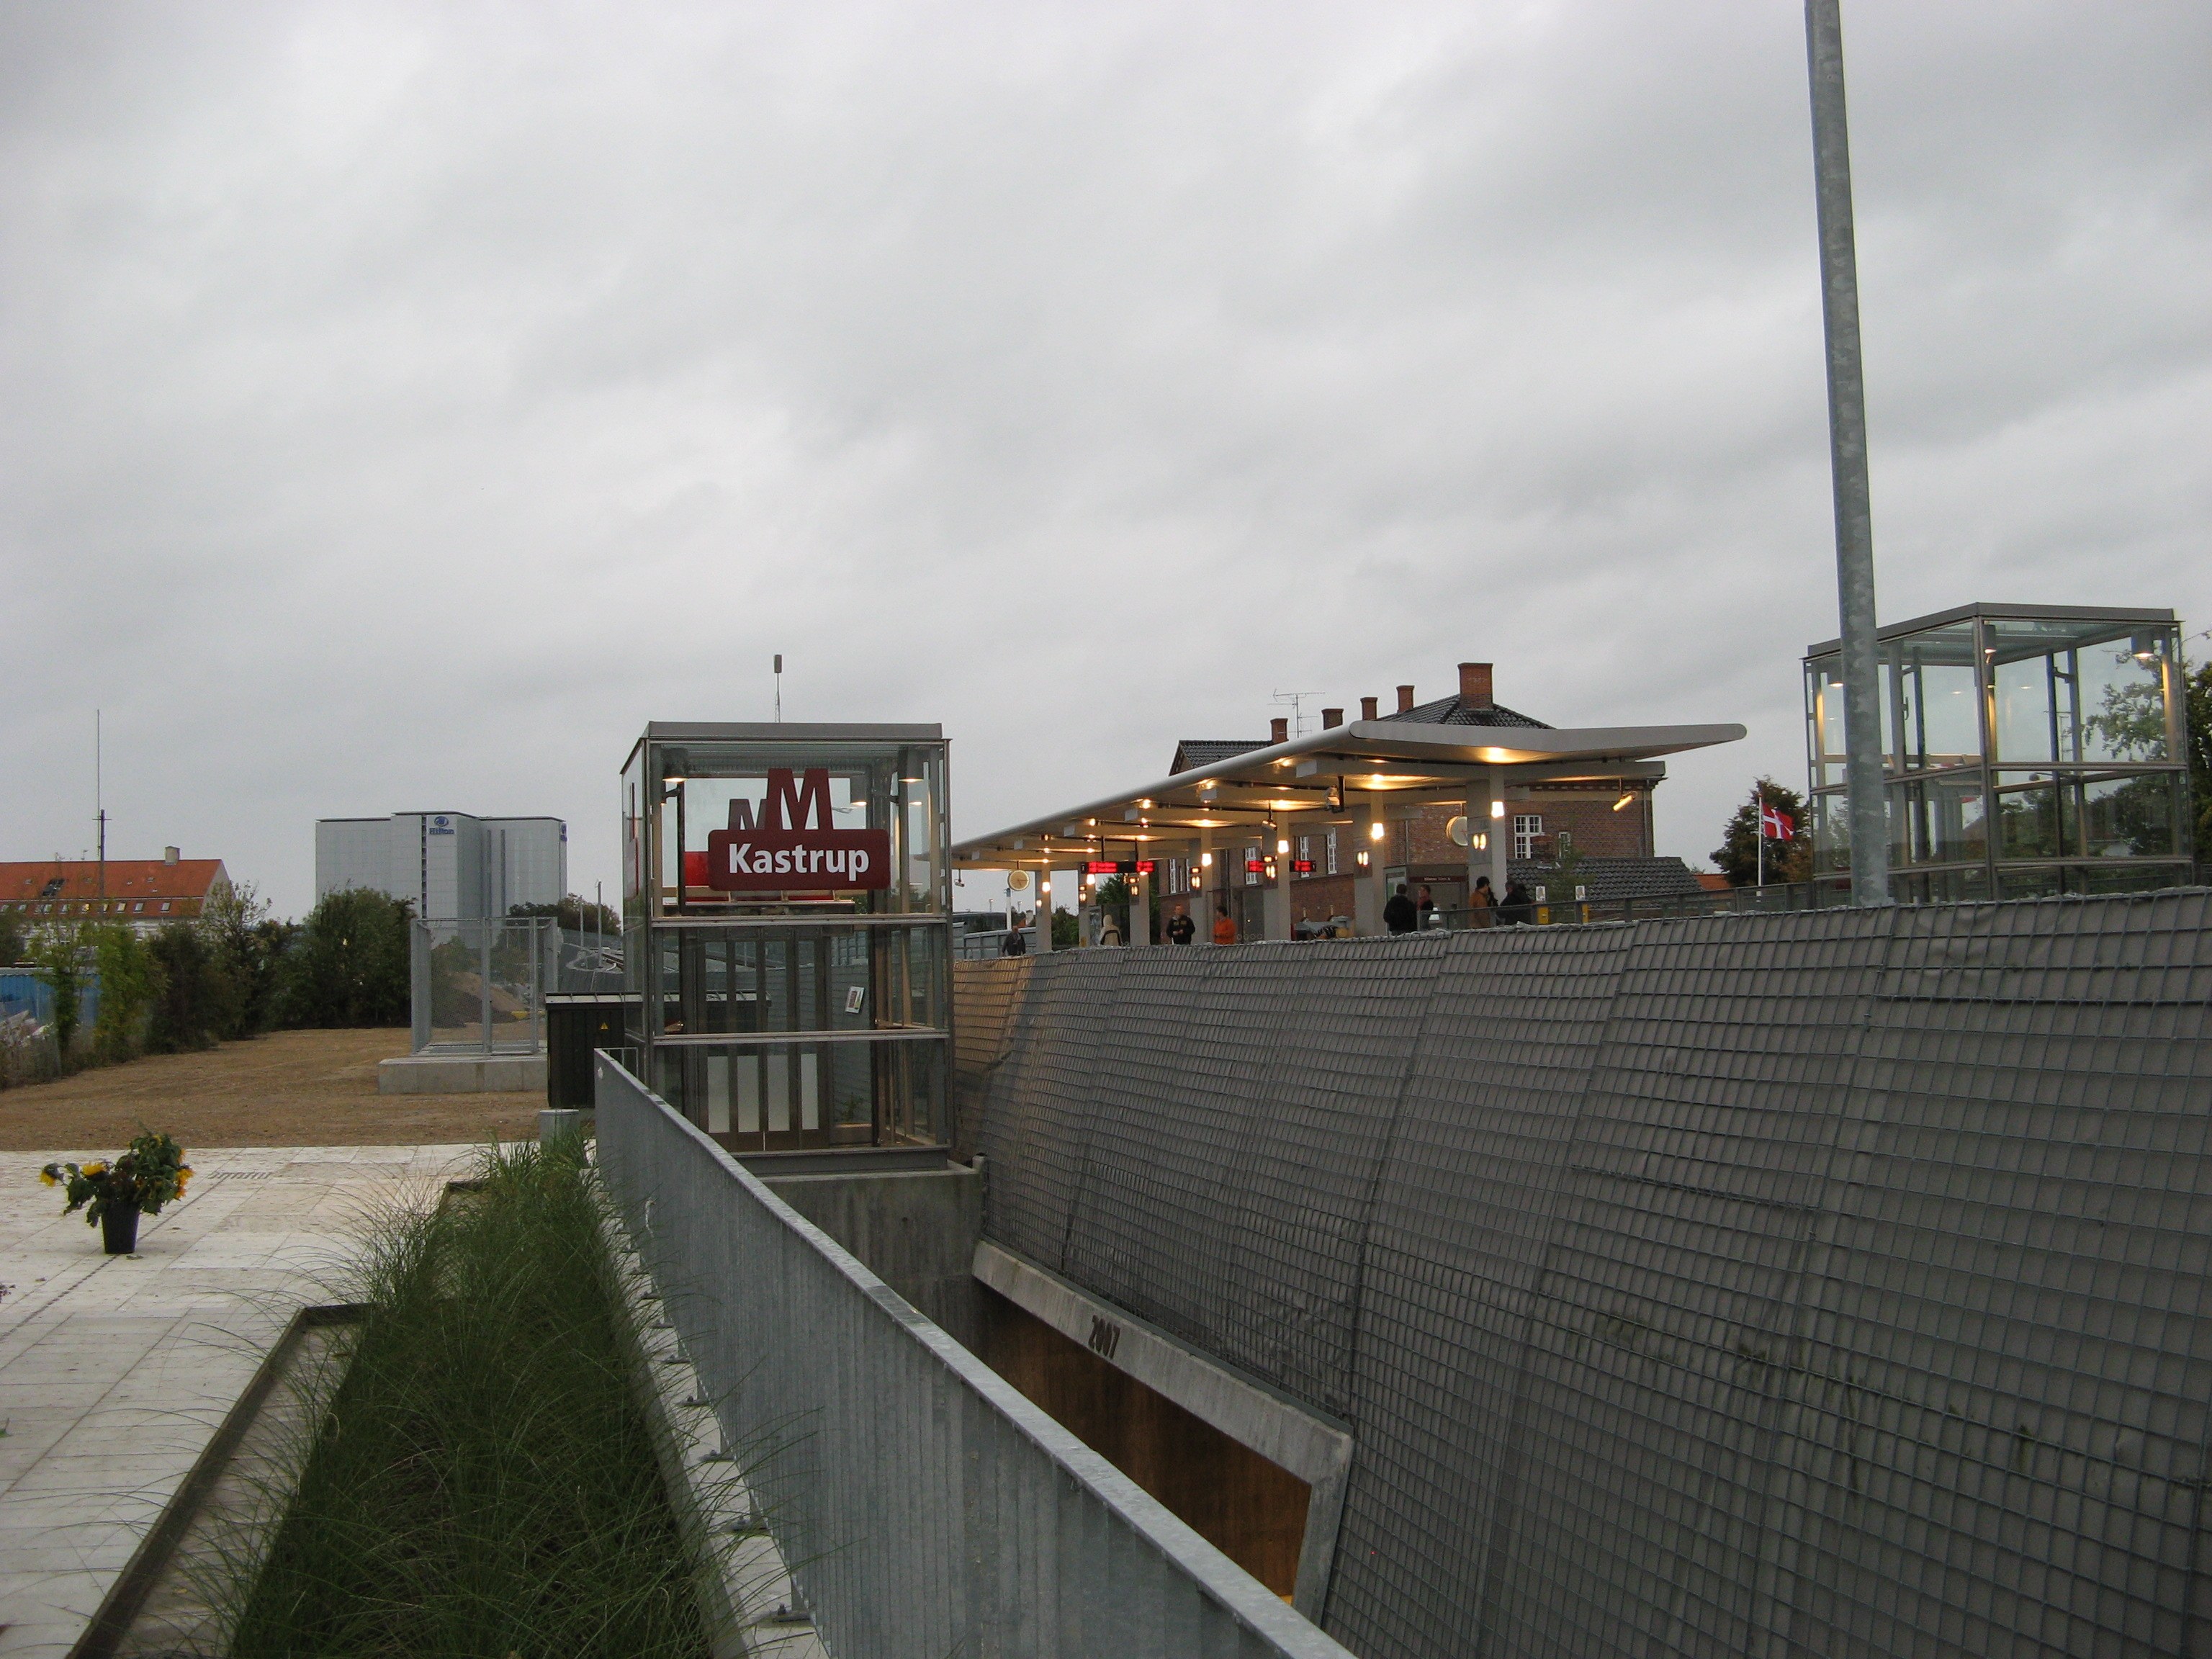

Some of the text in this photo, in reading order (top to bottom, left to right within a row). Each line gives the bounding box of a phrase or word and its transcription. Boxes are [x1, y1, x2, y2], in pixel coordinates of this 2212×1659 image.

[765, 768, 833, 830] M
[729, 843, 870, 881] Kastrup
[1088, 1314, 1120, 1359] 2007
